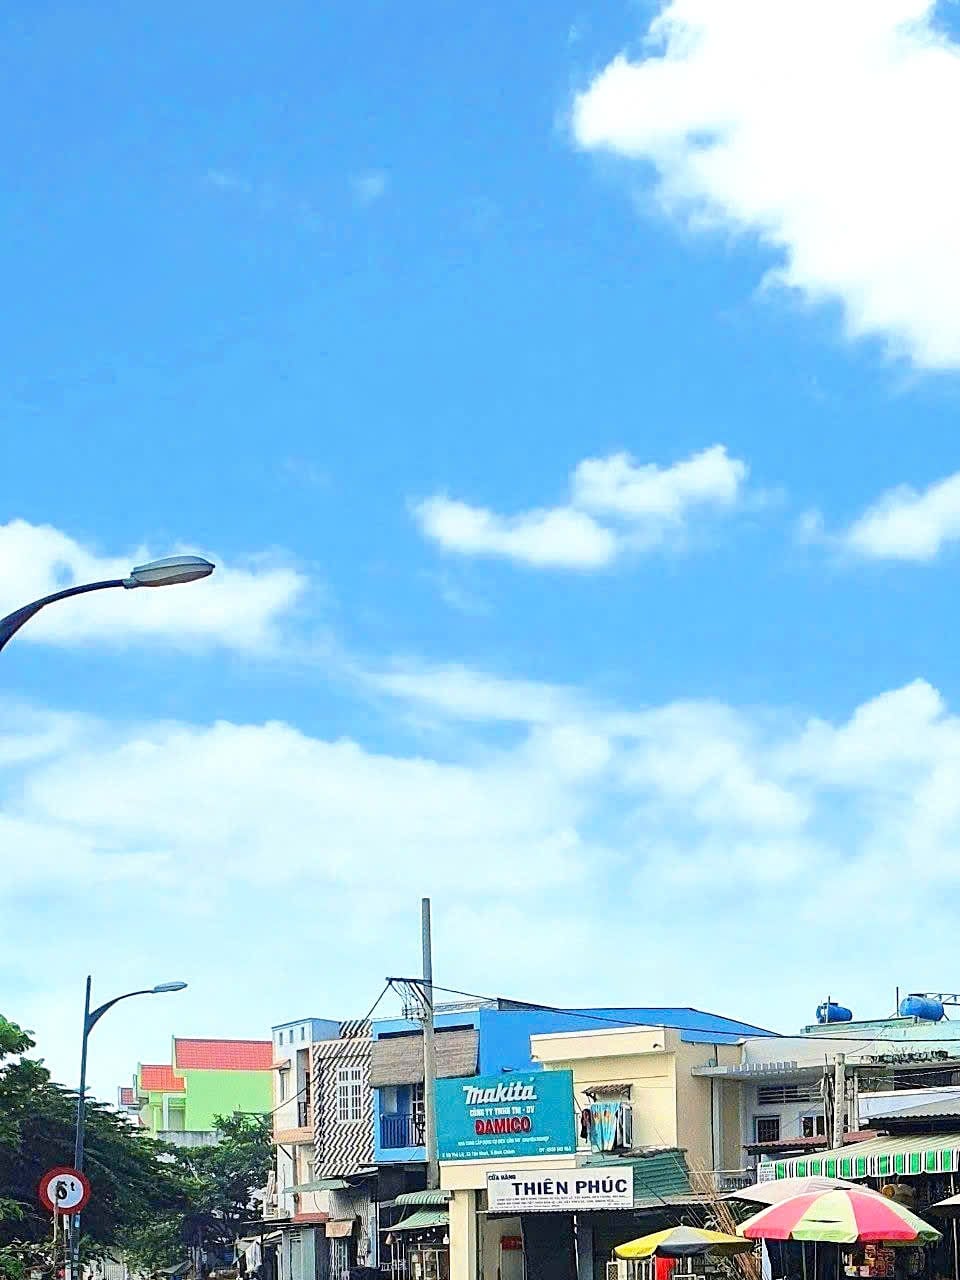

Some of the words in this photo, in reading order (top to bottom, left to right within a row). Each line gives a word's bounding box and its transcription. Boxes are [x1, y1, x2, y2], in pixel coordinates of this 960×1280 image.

[475, 1116, 532, 1135] DAMICO
[512, 1178, 568, 1196] THIÊN
[576, 1176, 627, 1194] PHÚC
